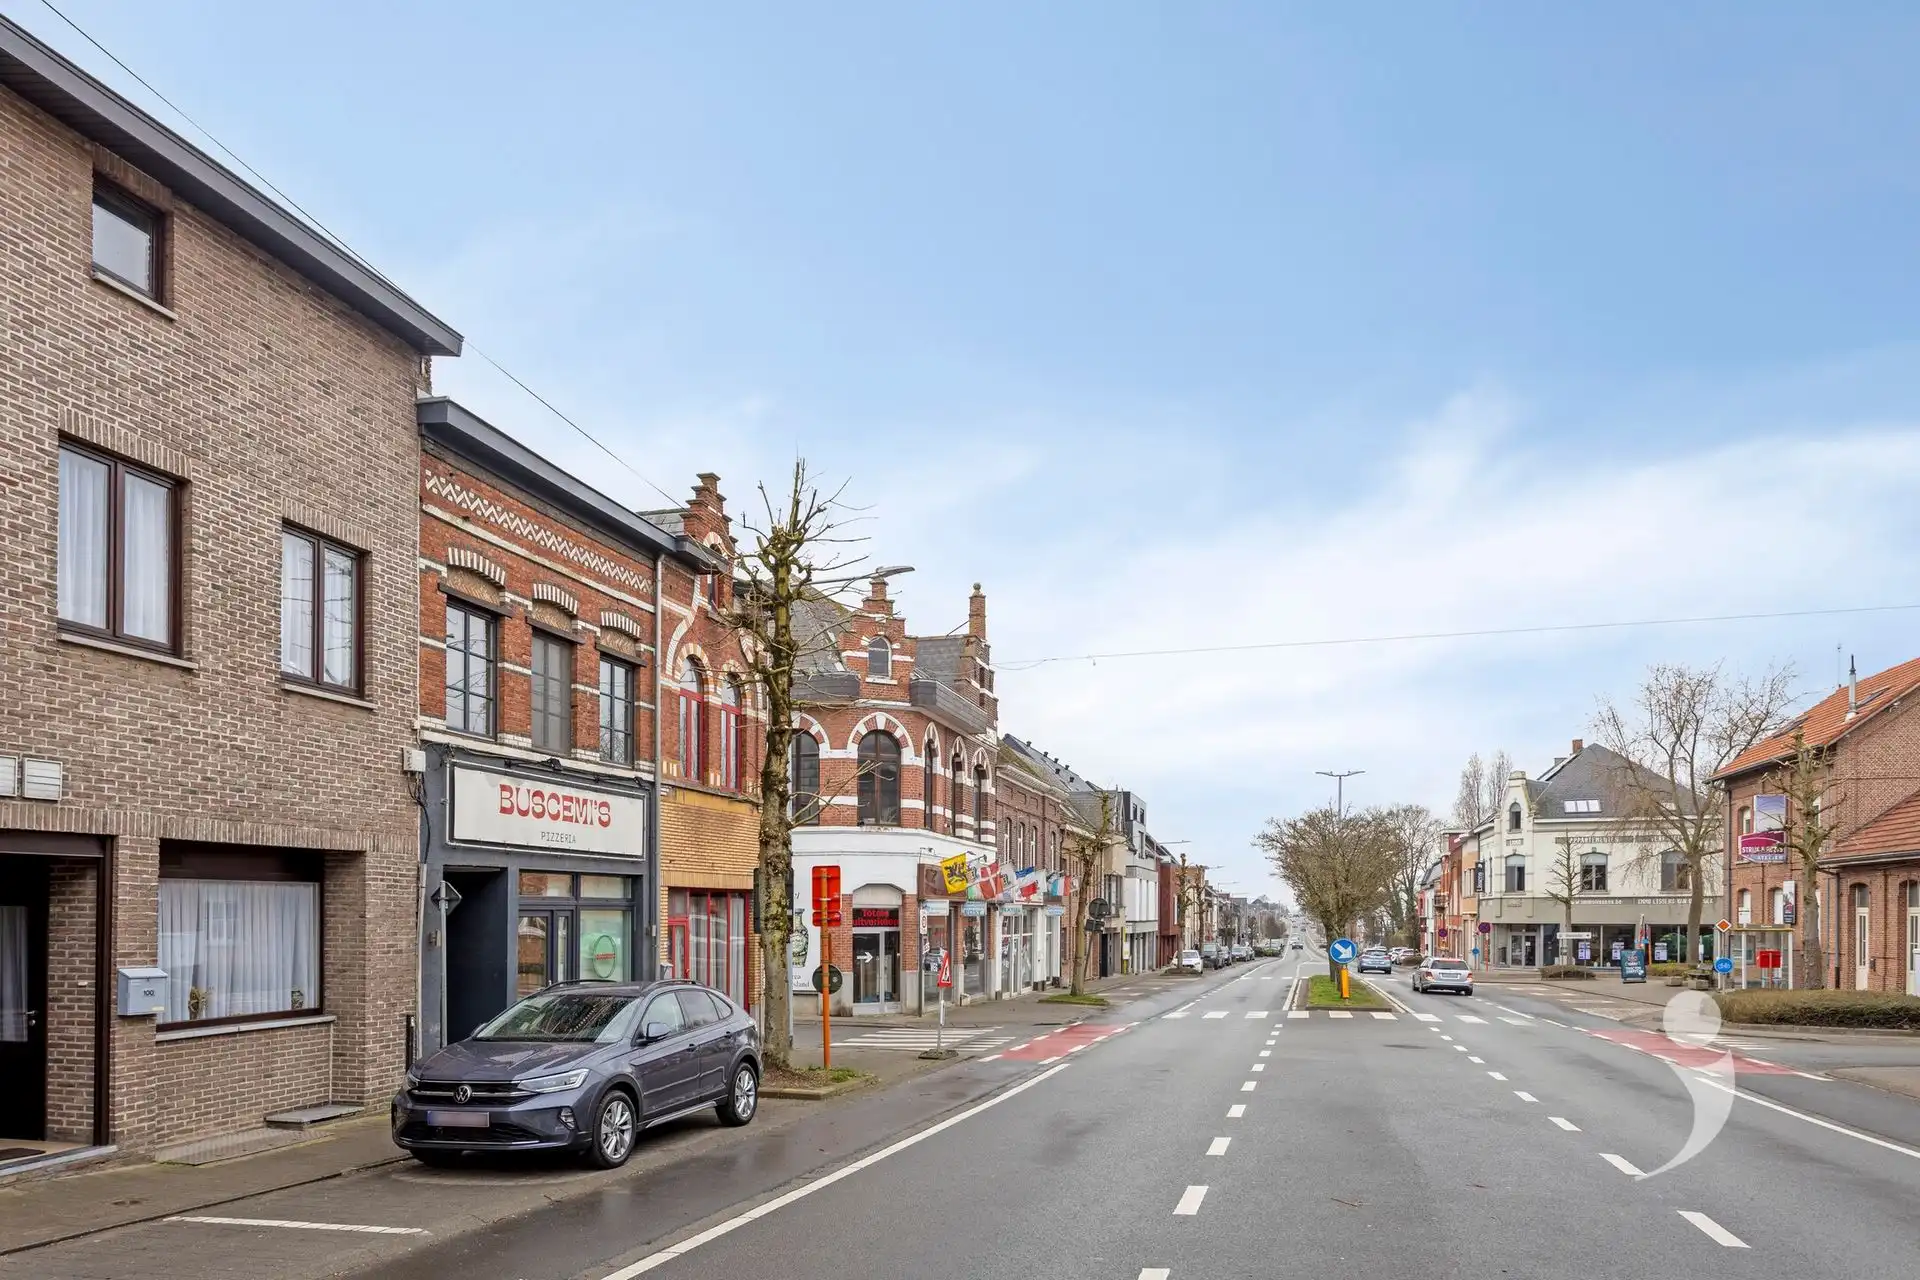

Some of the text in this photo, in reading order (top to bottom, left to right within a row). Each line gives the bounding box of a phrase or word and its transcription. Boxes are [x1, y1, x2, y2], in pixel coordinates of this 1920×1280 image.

[499, 783, 611, 828] BUSCEMI'S
[541, 831, 577, 844] PIZZERIA
[143, 989, 155, 997] 100
